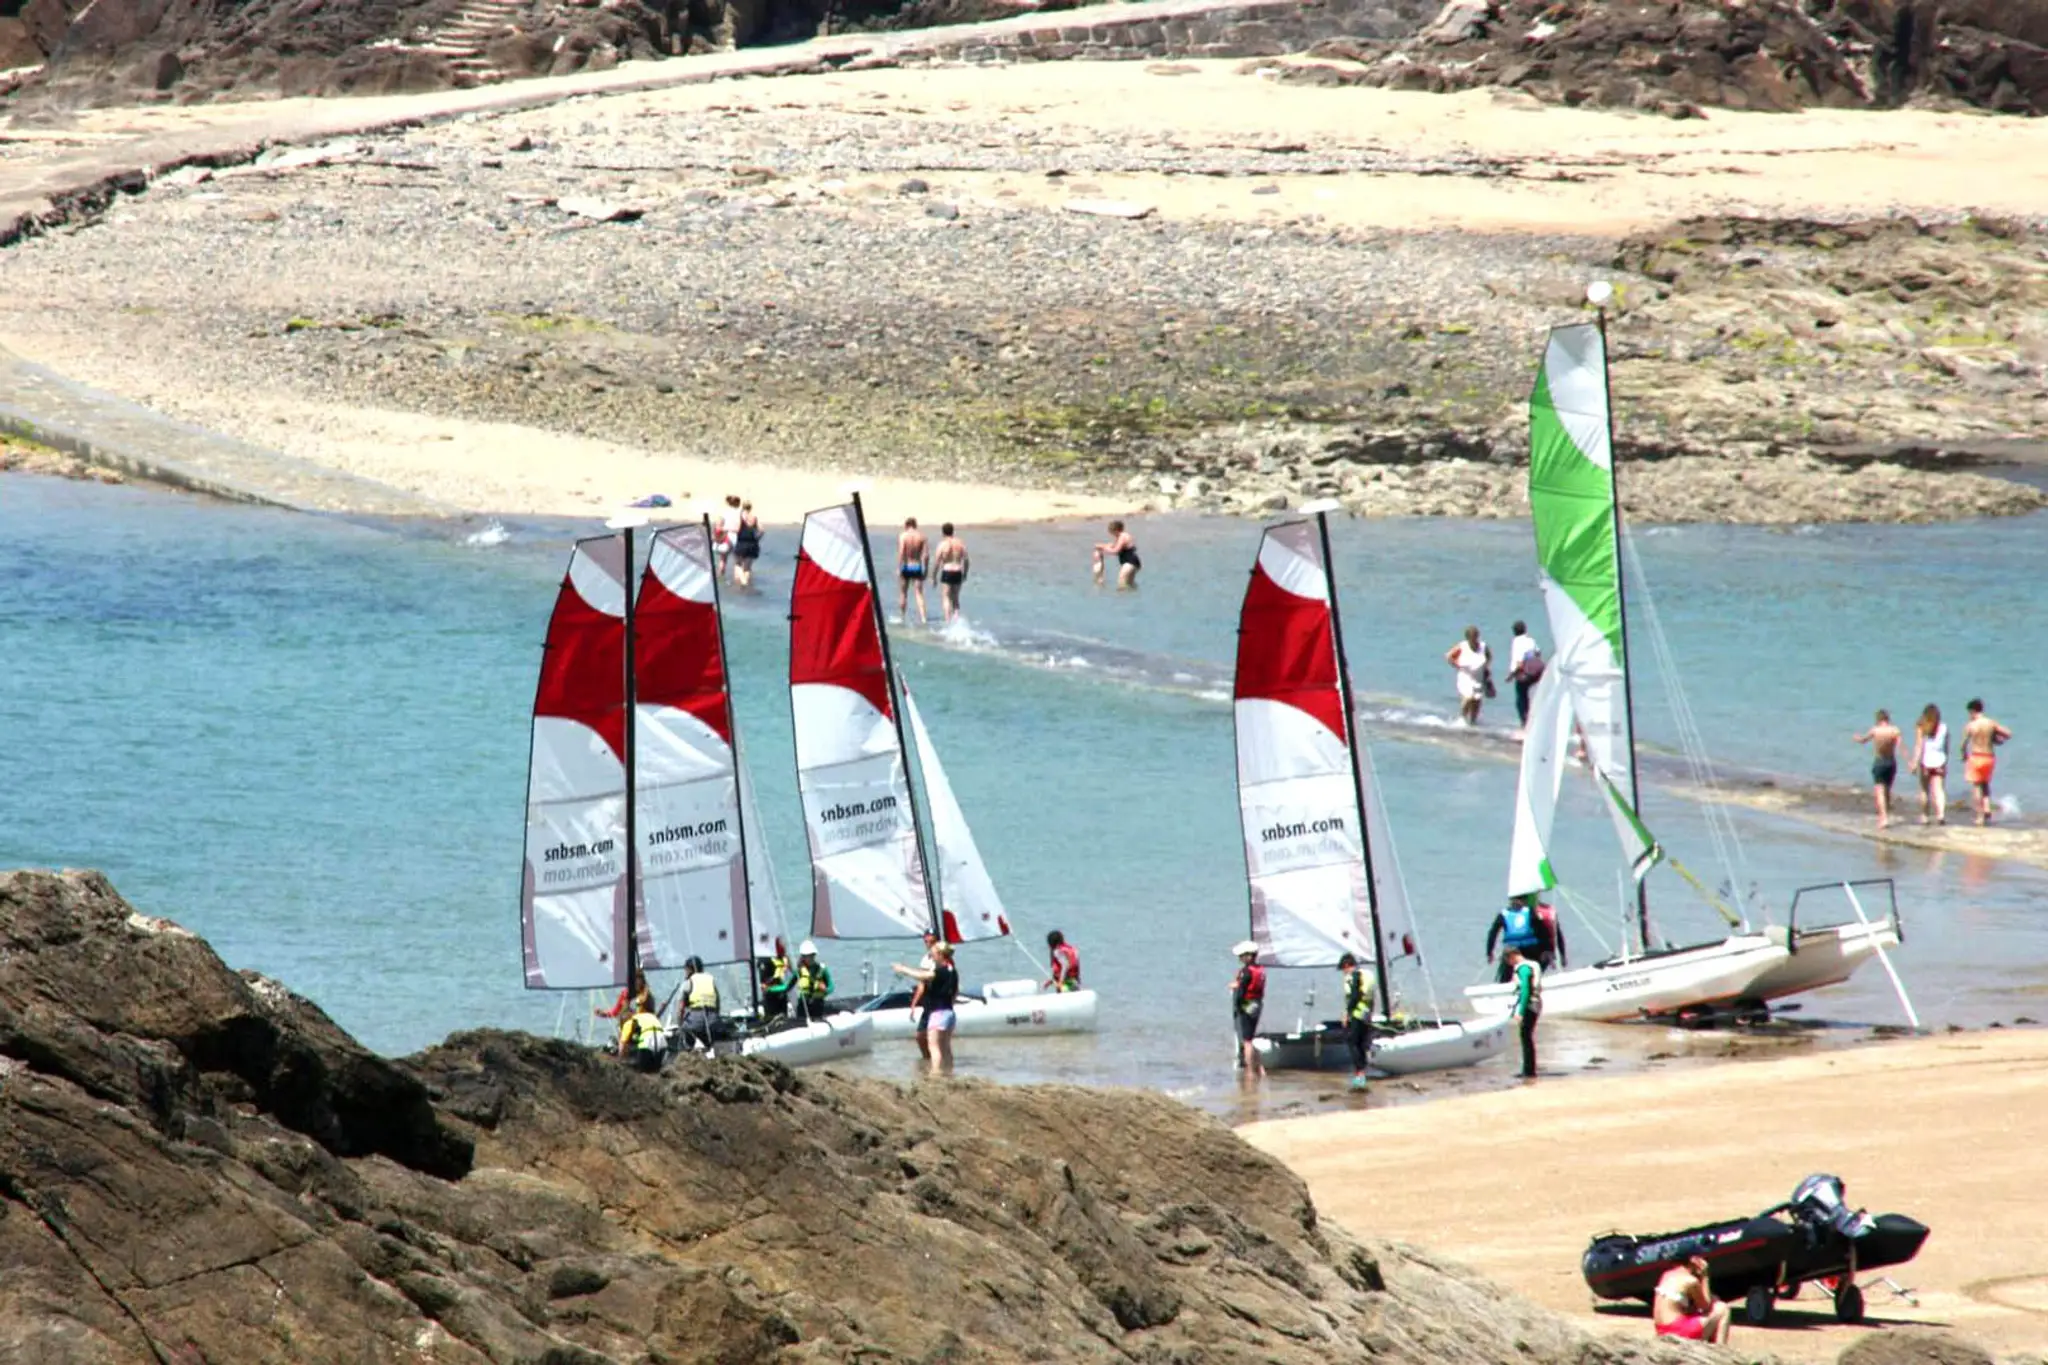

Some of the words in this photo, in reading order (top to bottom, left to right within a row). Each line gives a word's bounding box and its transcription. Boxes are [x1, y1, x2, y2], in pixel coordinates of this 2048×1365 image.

[821, 796, 897, 824] snbsm.com
[649, 818, 727, 846] snbsm.com
[1261, 816, 1344, 843] snbsm.com
[544, 839, 614, 862] snbsm.com
